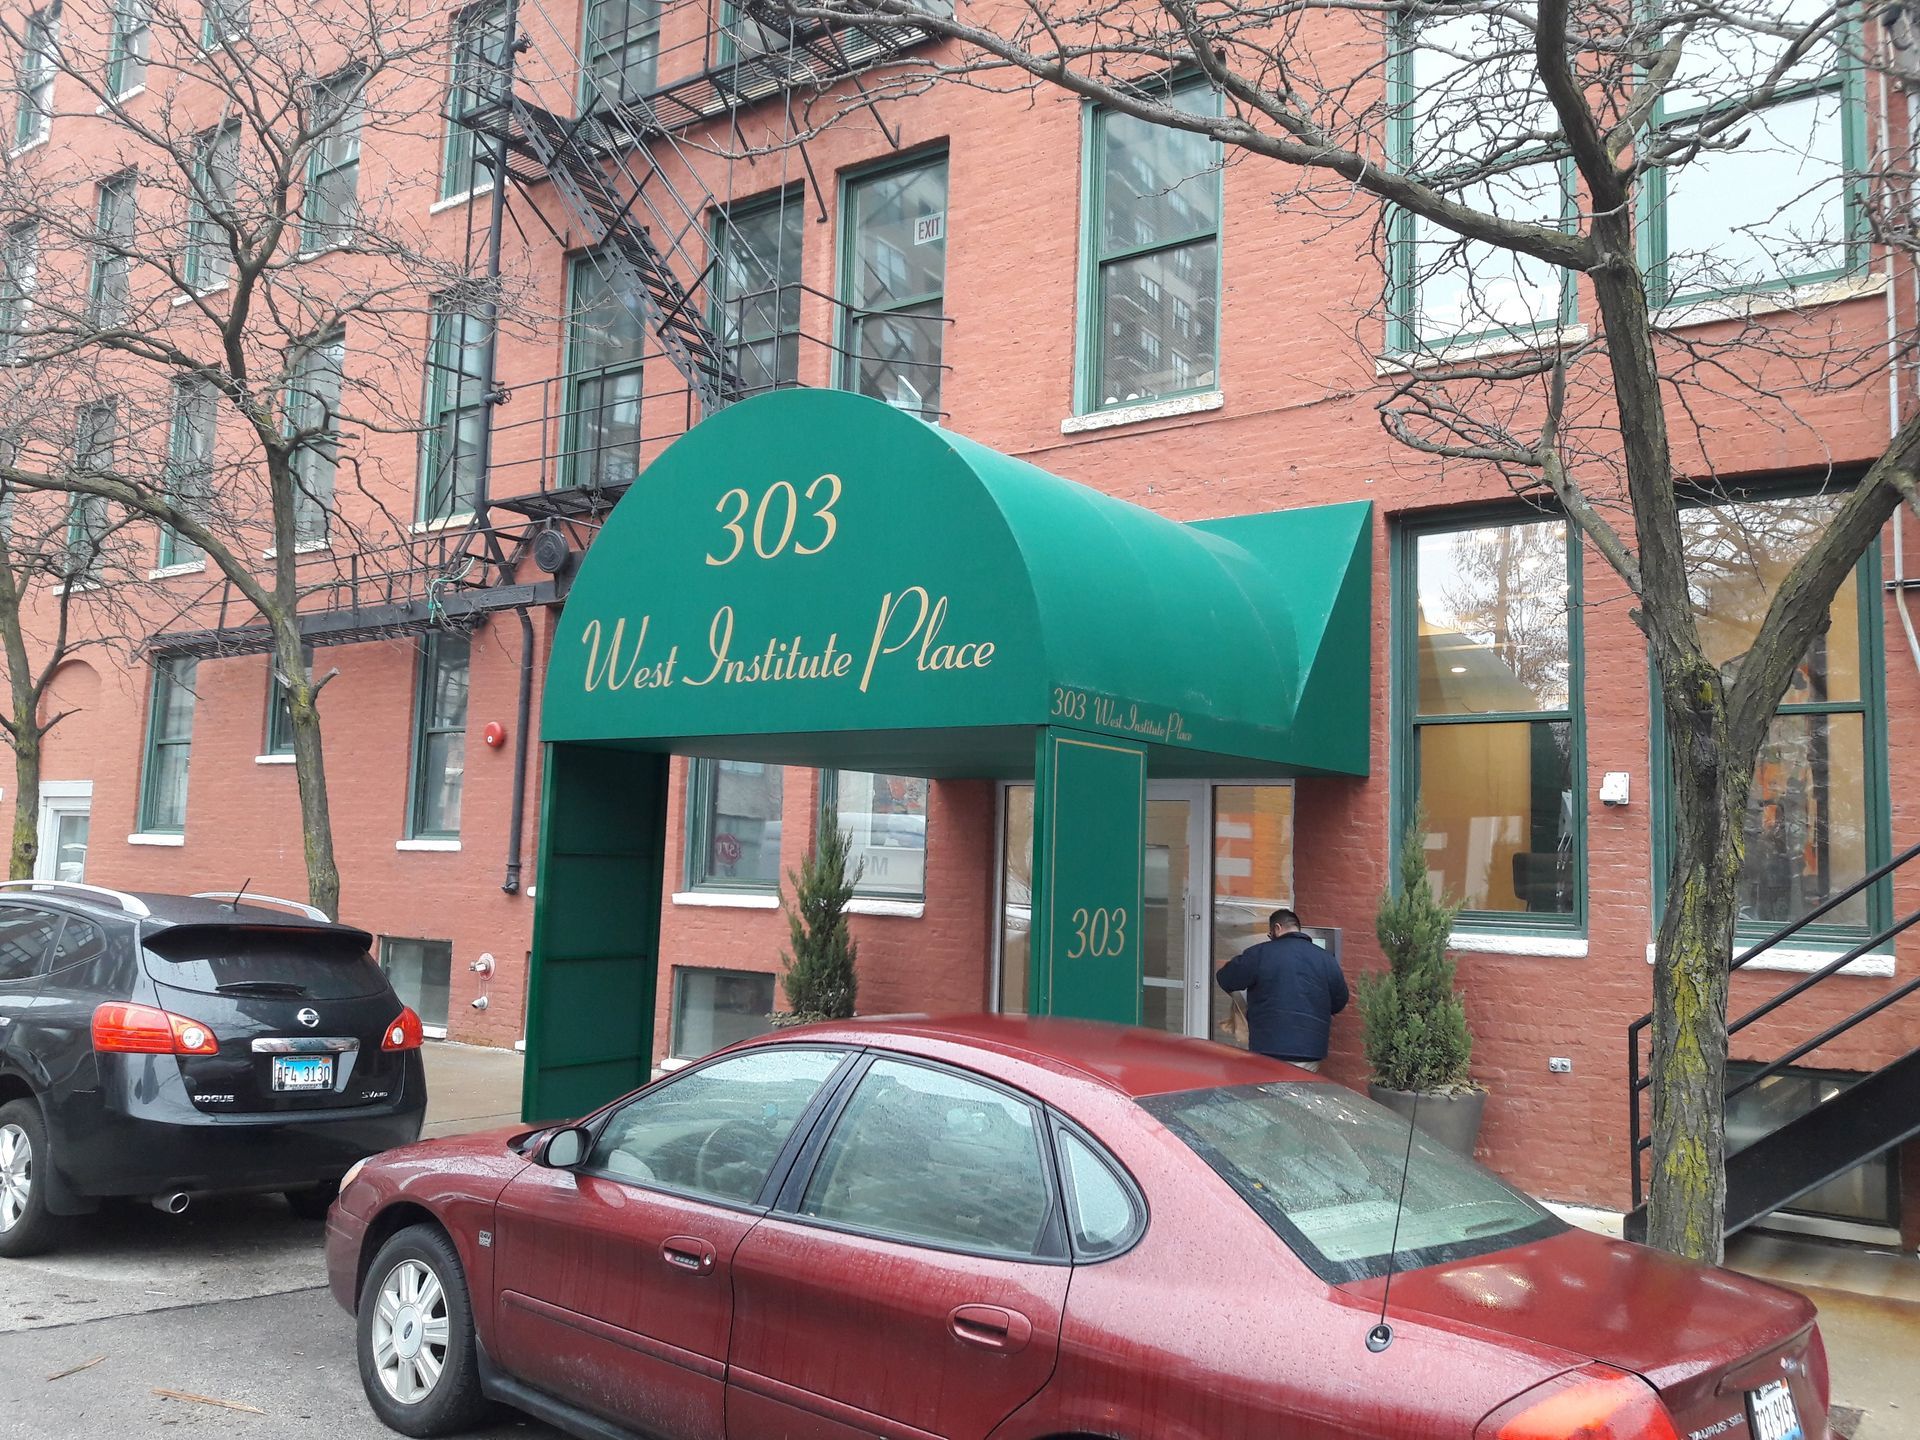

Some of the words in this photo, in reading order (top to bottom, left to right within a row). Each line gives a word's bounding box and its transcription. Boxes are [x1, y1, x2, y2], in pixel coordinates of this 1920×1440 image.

[918, 216, 941, 241] EXIT
[705, 473, 842, 566] 303
[581, 614, 680, 692] West
[681, 605, 852, 686] Institute
[858, 585, 995, 694] Place
[1051, 687, 1087, 721] 303
[1094, 696, 1123, 729] West
[1123, 704, 1166, 737] Institute
[1165, 712, 1193, 743] Place
[1067, 907, 1127, 959] 303
[277, 1066, 297, 1082] AF4
[303, 1065, 331, 1082] 3130
[193, 1094, 235, 1103] ROGUE
[1688, 1420, 1728, 1440] TAURUS
